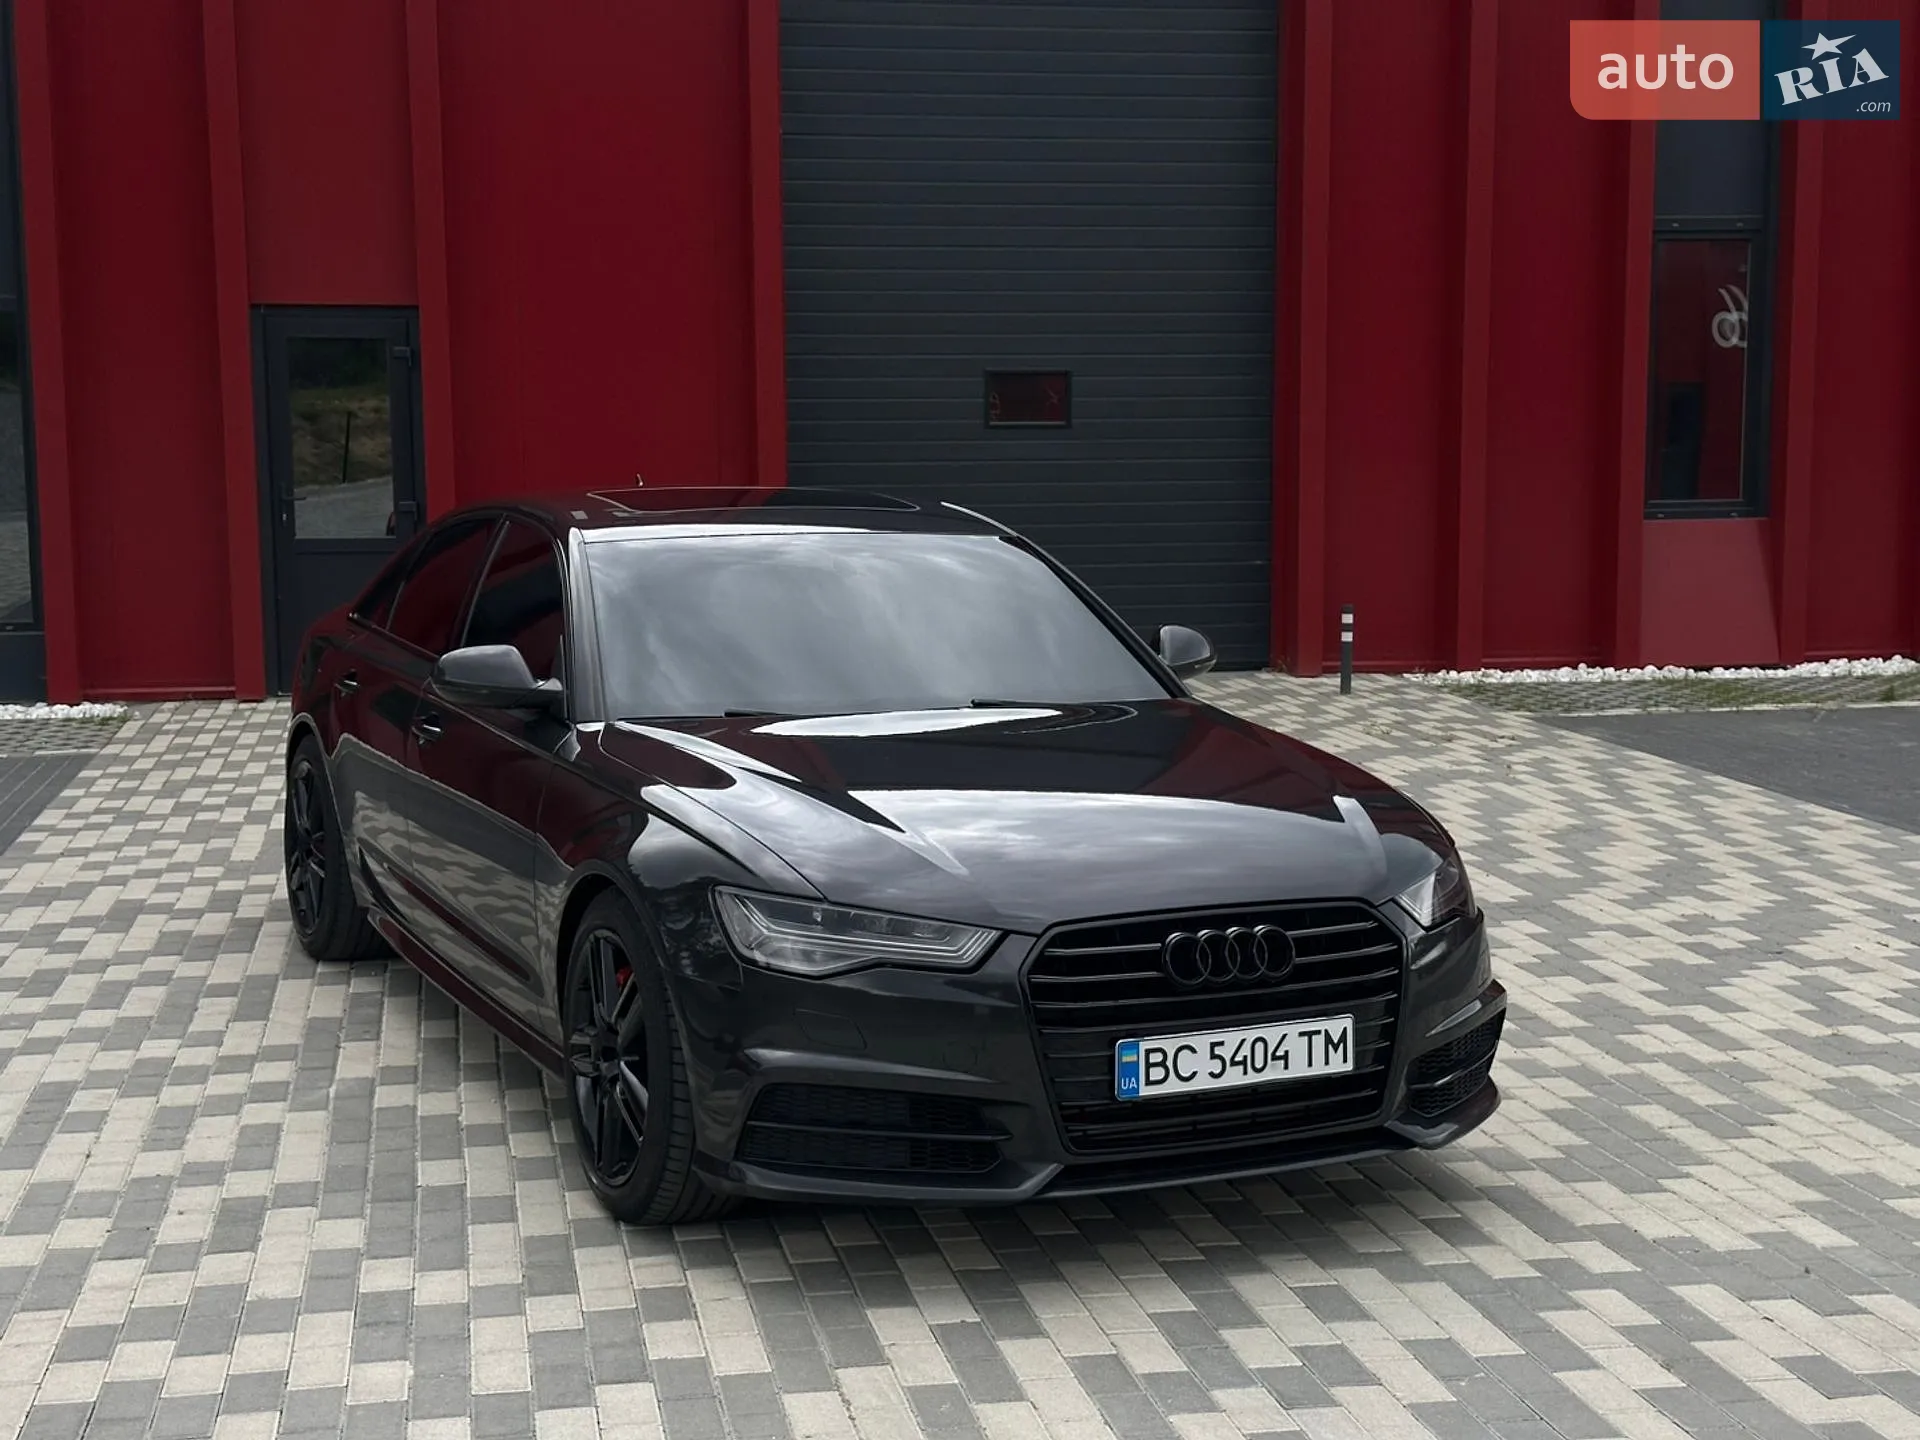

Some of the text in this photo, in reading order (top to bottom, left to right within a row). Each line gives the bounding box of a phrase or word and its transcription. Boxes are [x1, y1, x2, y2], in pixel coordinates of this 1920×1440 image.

[1143, 1026, 1348, 1087] BC 5404 TM
[1121, 1076, 1138, 1090] UA
